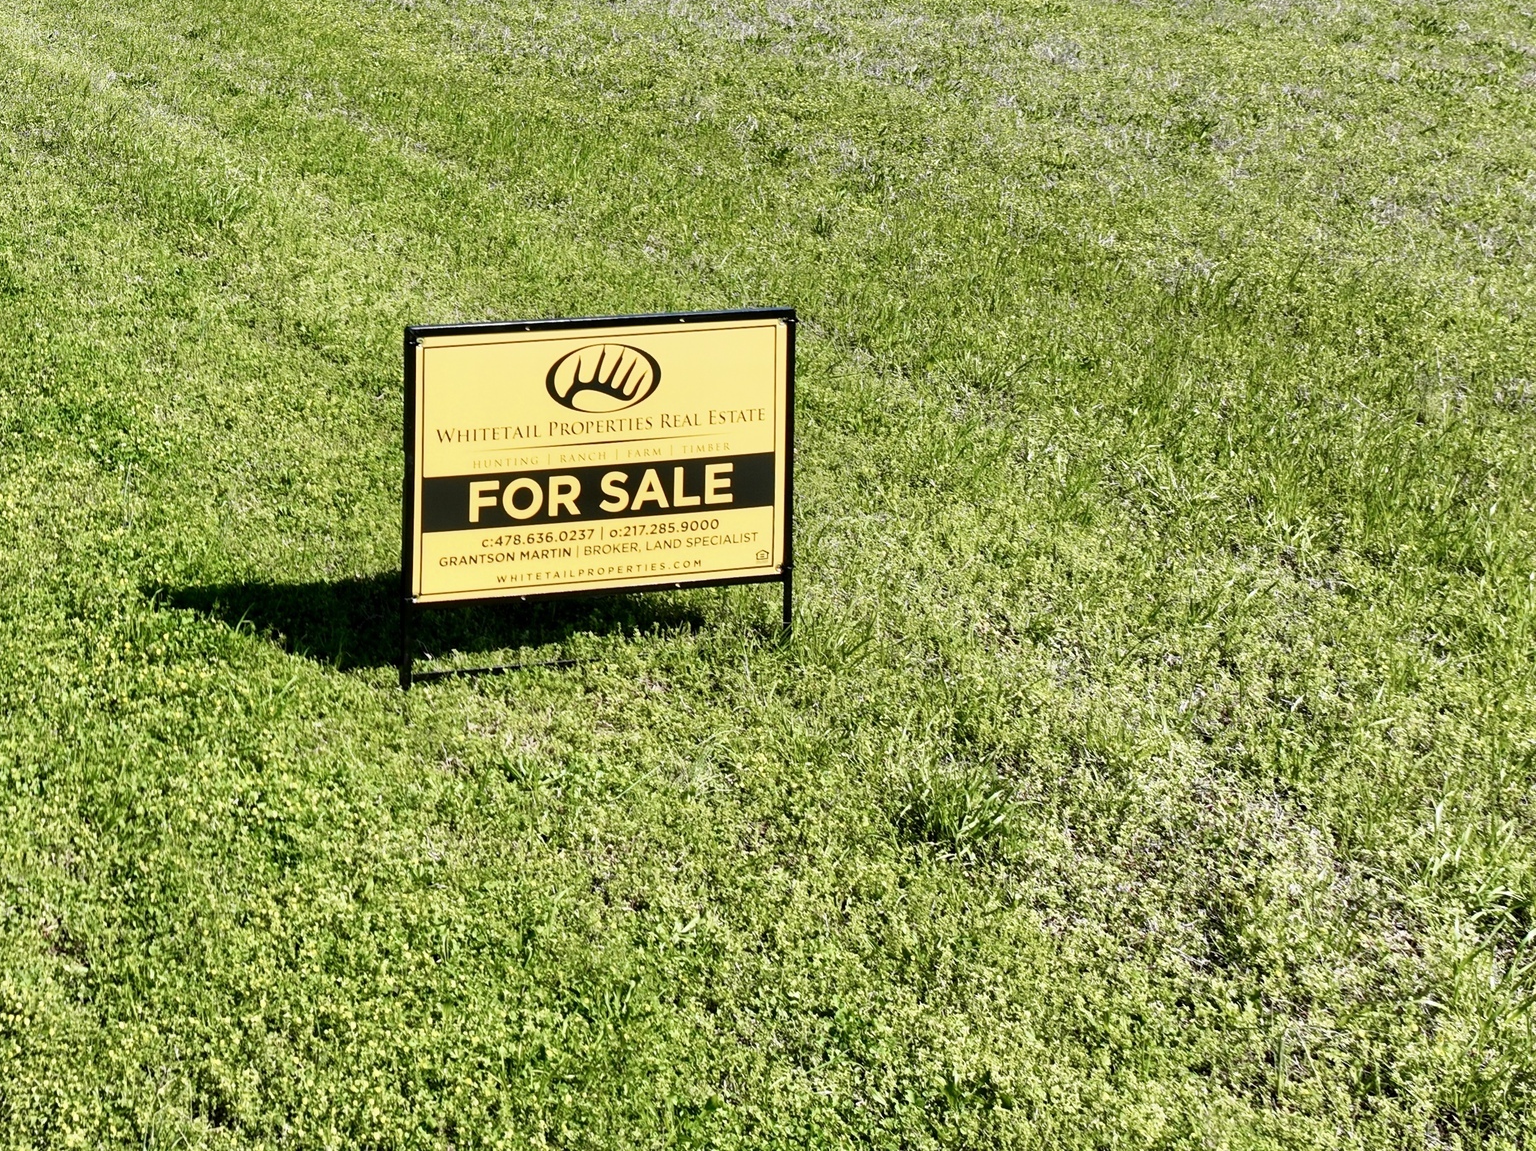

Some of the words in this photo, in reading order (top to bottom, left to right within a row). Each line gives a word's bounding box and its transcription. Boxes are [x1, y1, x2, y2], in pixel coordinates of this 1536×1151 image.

[437, 425, 542, 444] WHITETAIL
[548, 418, 653, 436] PROPERTIES
[661, 412, 702, 429] REAL
[708, 407, 766, 425] ESTATE
[473, 455, 540, 469] HUNTING
[560, 450, 607, 463] RANCH
[627, 446, 663, 458] FARM
[682, 442, 731, 455] TIMBER
[468, 476, 581, 523] FOR
[599, 462, 734, 513] SALE
[481, 528, 595, 548] c:478.636.0237
[609, 519, 720, 538] o:217.285.9000
[439, 551, 515, 568] GRANTSON
[520, 547, 572, 561] MARTIN
[584, 541, 642, 558] BROKER,
[645, 538, 683, 551] LAND
[686, 532, 759, 548] SPECIALIST
[496, 559, 702, 583] WHITETAILPROPERTIES.COM
